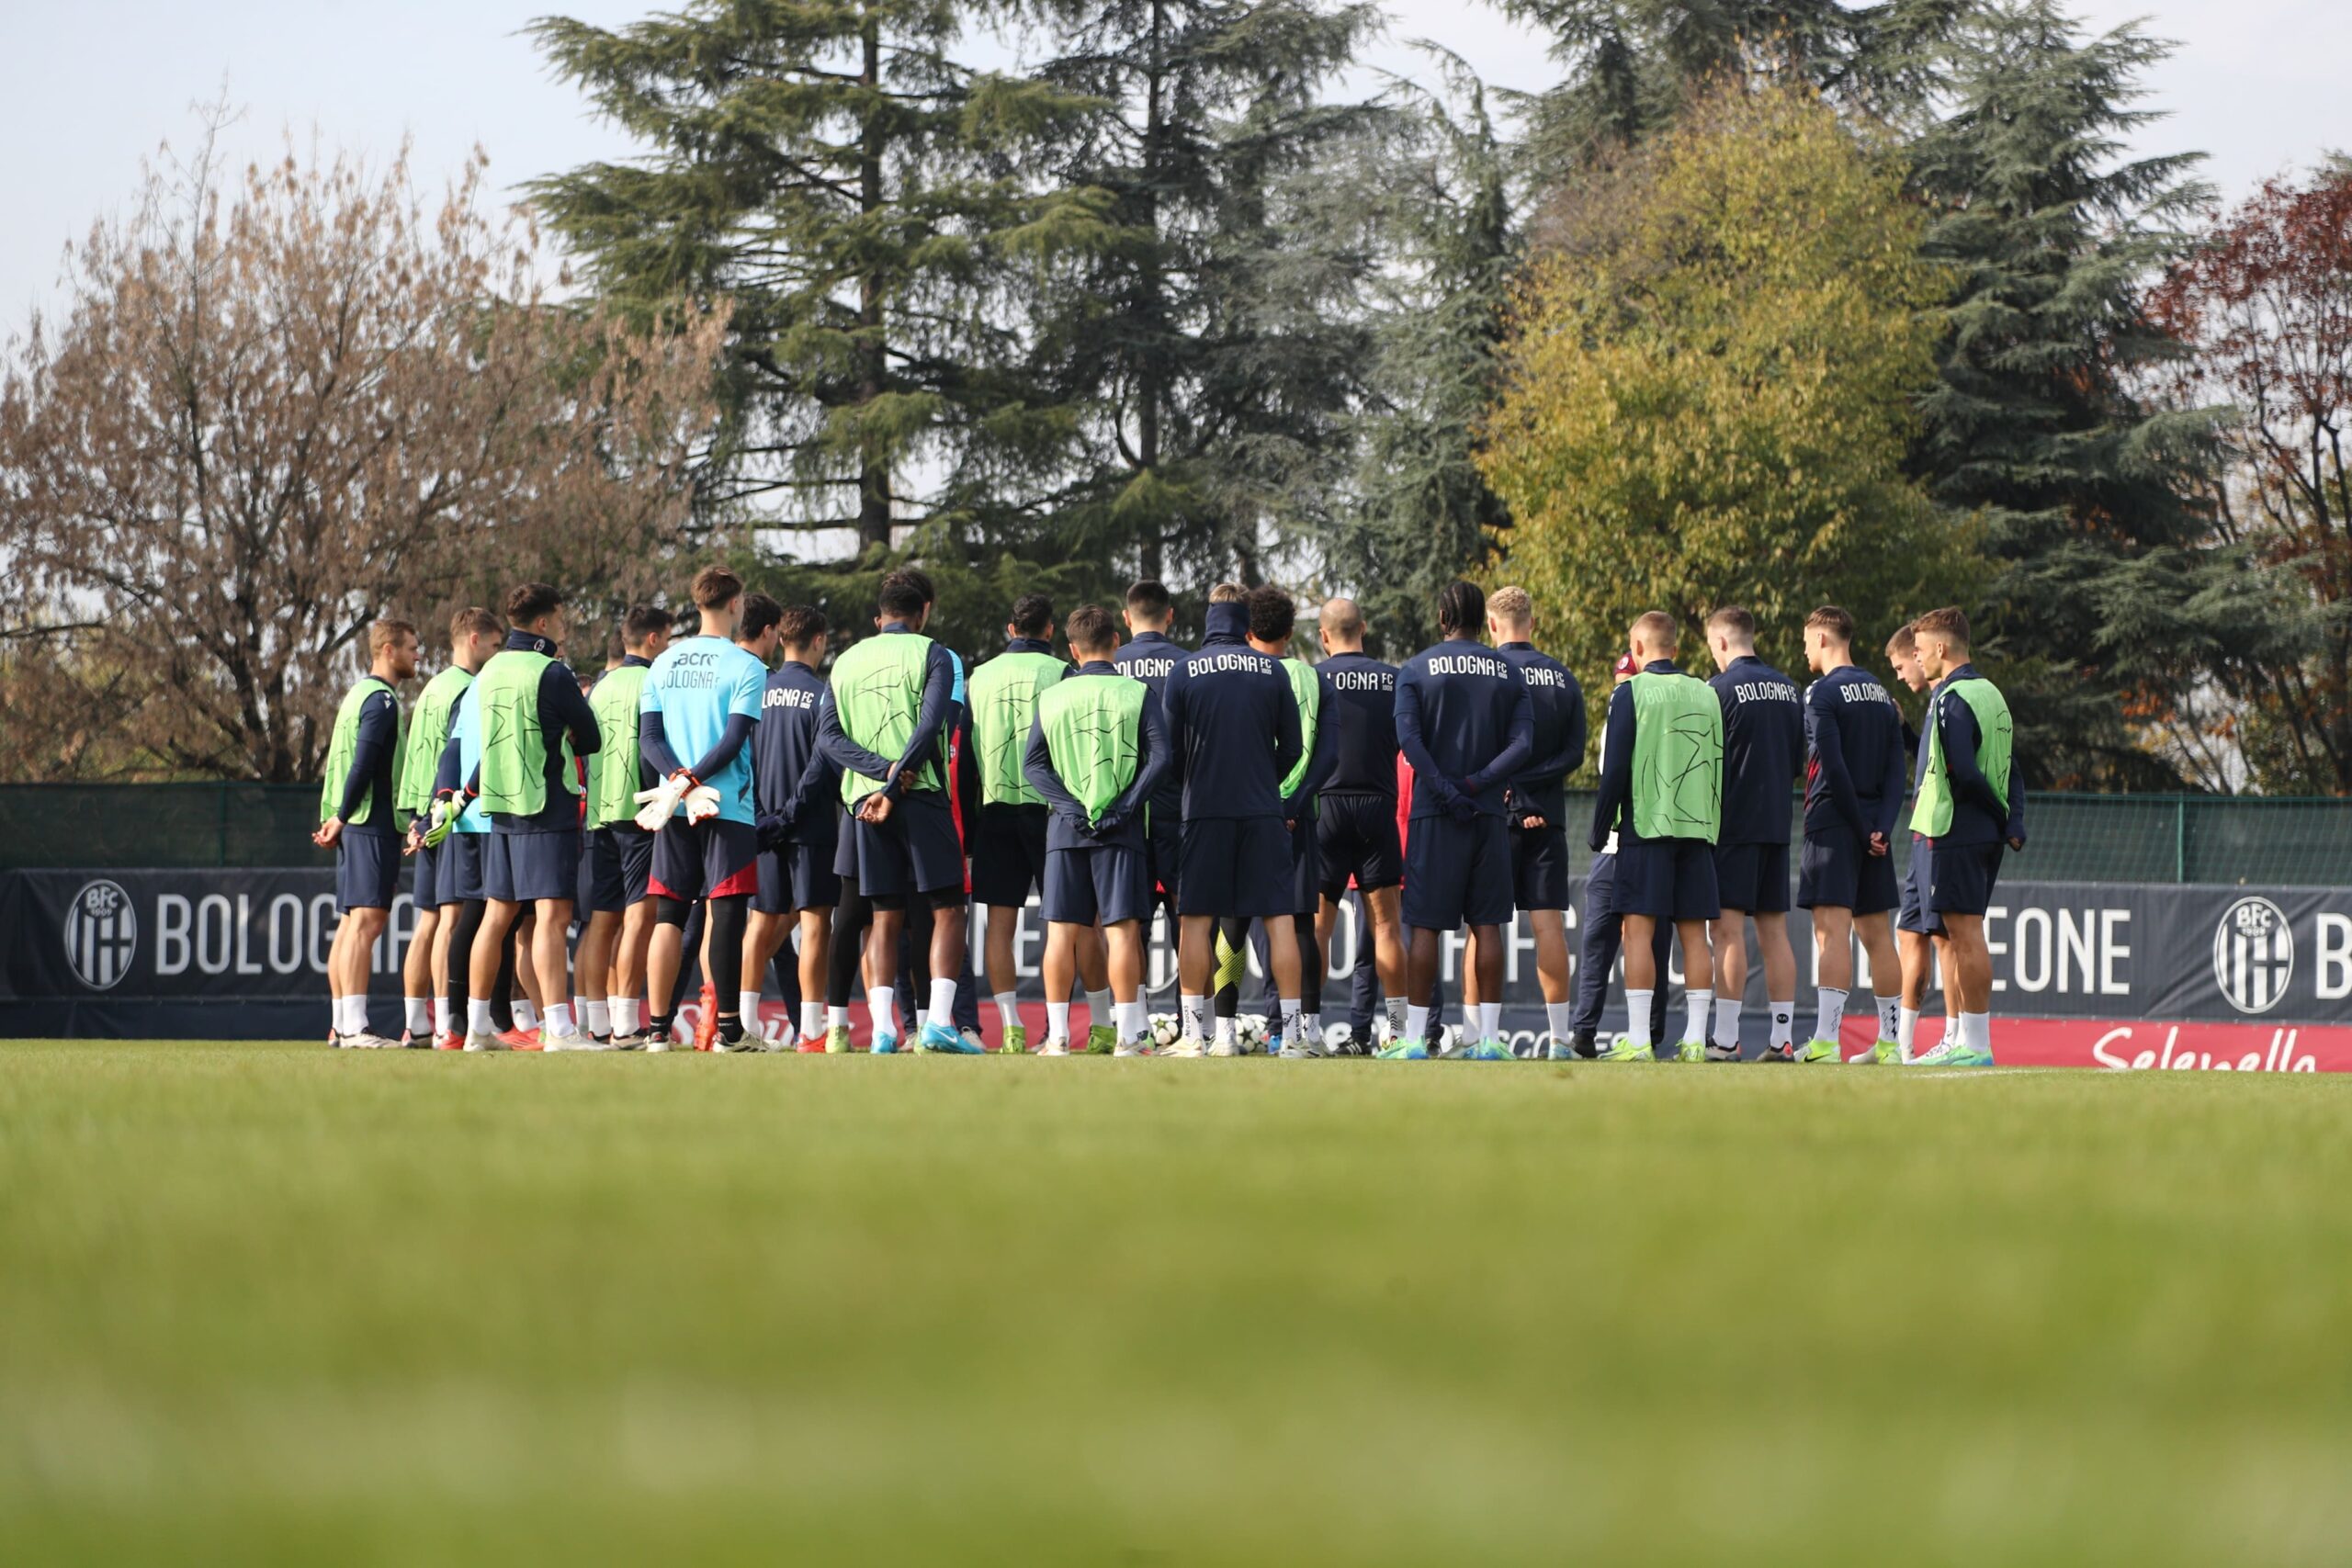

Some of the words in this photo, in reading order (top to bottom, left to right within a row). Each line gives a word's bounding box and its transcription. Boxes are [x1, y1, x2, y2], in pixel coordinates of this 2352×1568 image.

[1114, 659, 1175, 678] OLOGNA
[1188, 654, 1259, 678] BOLOGNA
[1260, 657, 1272, 669] FC
[1429, 655, 1495, 676] BOLOGNA
[1497, 661, 1507, 673] FC
[1555, 670, 1565, 682] FC
[1327, 671, 1378, 690] OGNA
[1382, 672, 1394, 684] FC
[762, 688, 801, 708] LOGNA
[801, 691, 814, 704] FC
[1735, 682, 1790, 704] BOLOGNA
[1840, 682, 1886, 704] BOLOGNA
[86, 886, 118, 909] BFC
[2236, 903, 2272, 928] BFC
[156, 893, 421, 976] BOLOGA
[1935, 906, 2131, 995] EONE
[2316, 913, 2352, 999] B
